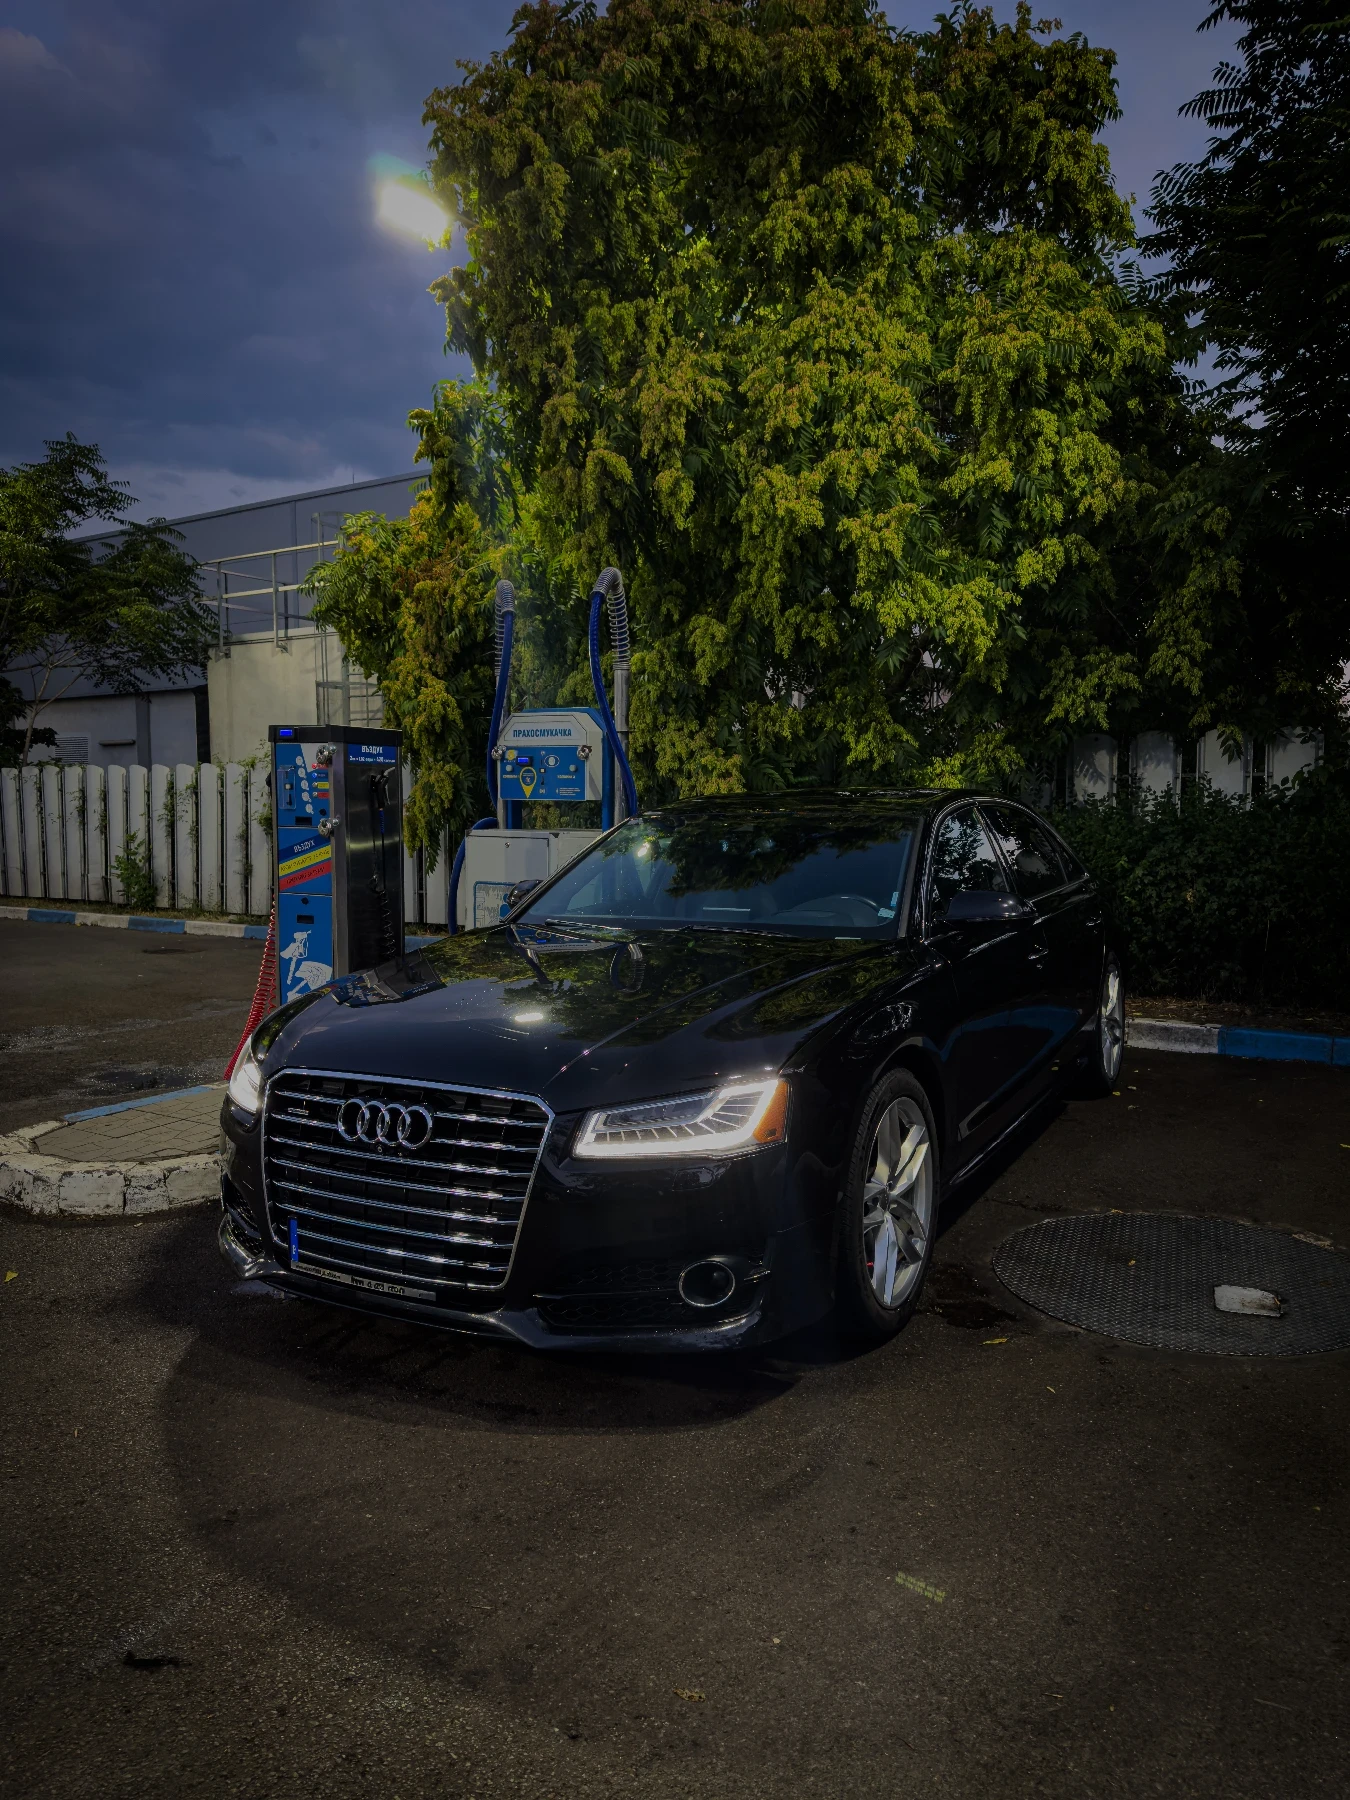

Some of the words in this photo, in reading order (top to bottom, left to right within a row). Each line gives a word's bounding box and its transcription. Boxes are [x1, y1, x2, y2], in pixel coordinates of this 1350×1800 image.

[513, 728, 572, 738] ПРАХОСМУКАЧКА
[361, 746, 383, 754] ВЪЗДУХ
[293, 839, 316, 853] ВЪЗДУХ
